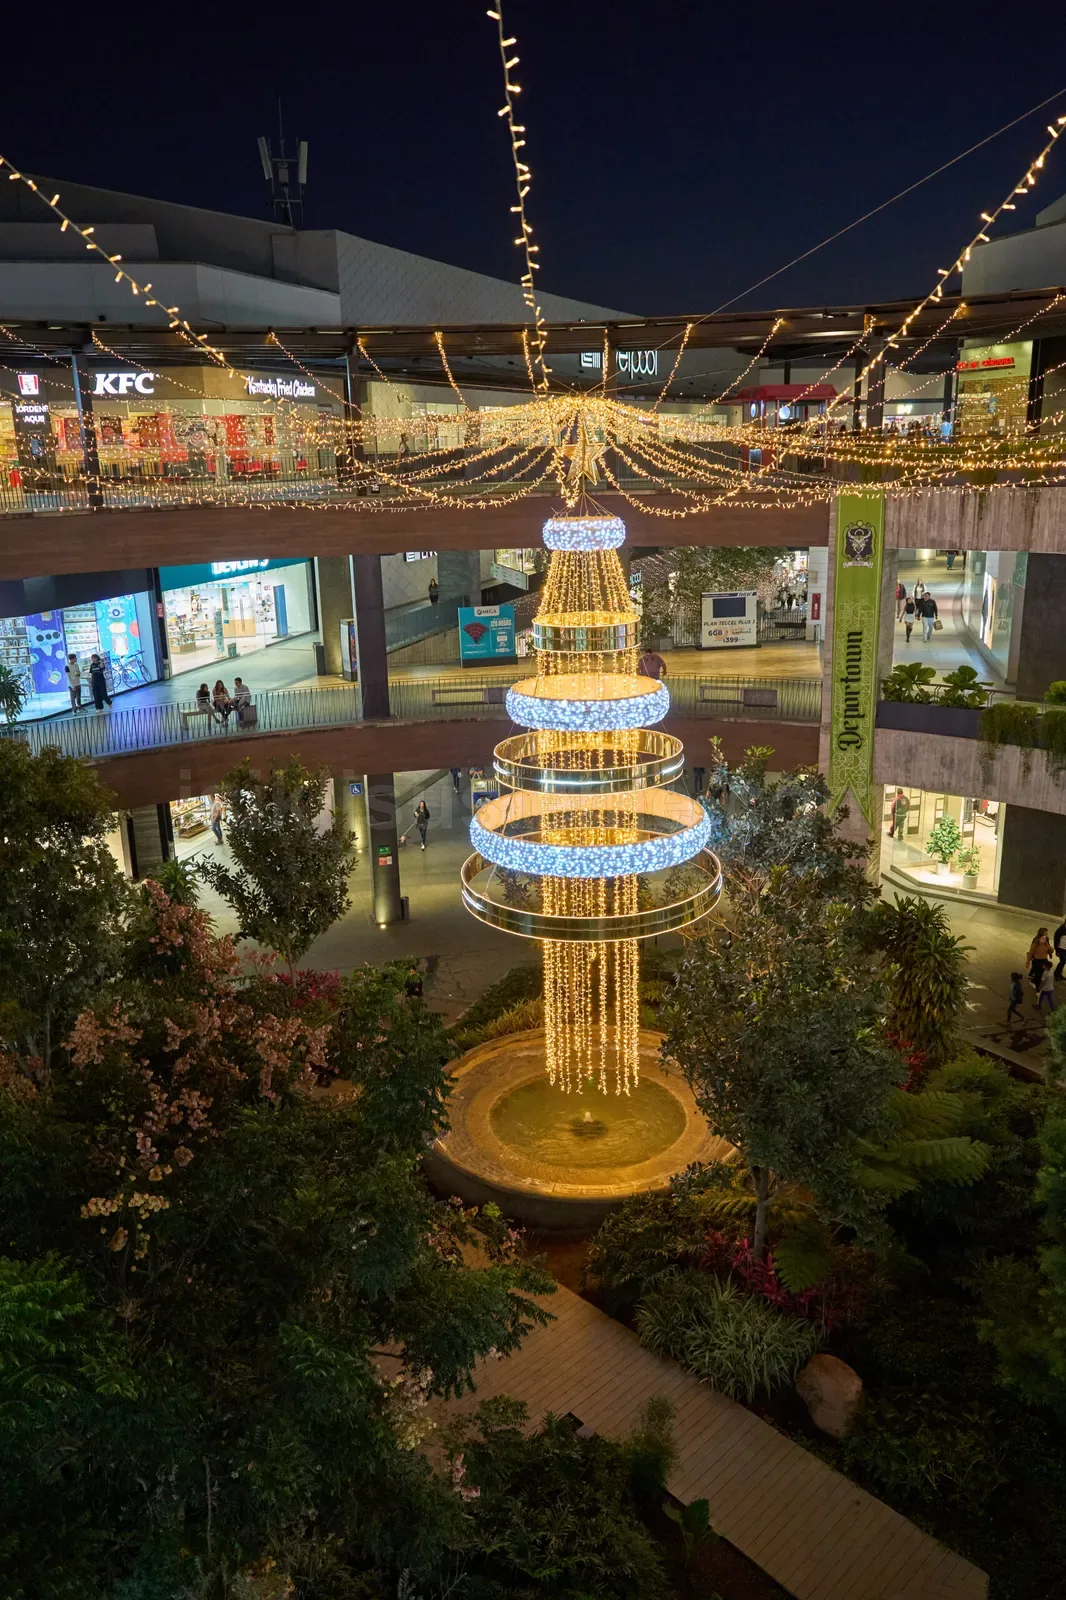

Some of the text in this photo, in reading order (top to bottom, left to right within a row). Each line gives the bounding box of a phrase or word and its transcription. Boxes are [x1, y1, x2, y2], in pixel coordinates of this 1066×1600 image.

[93, 373, 155, 394] KFC
[248, 376, 316, 398] Kentucky Fried Chicken
[708, 629, 723, 637] 6GB
[838, 630, 865, 752] Deportown
